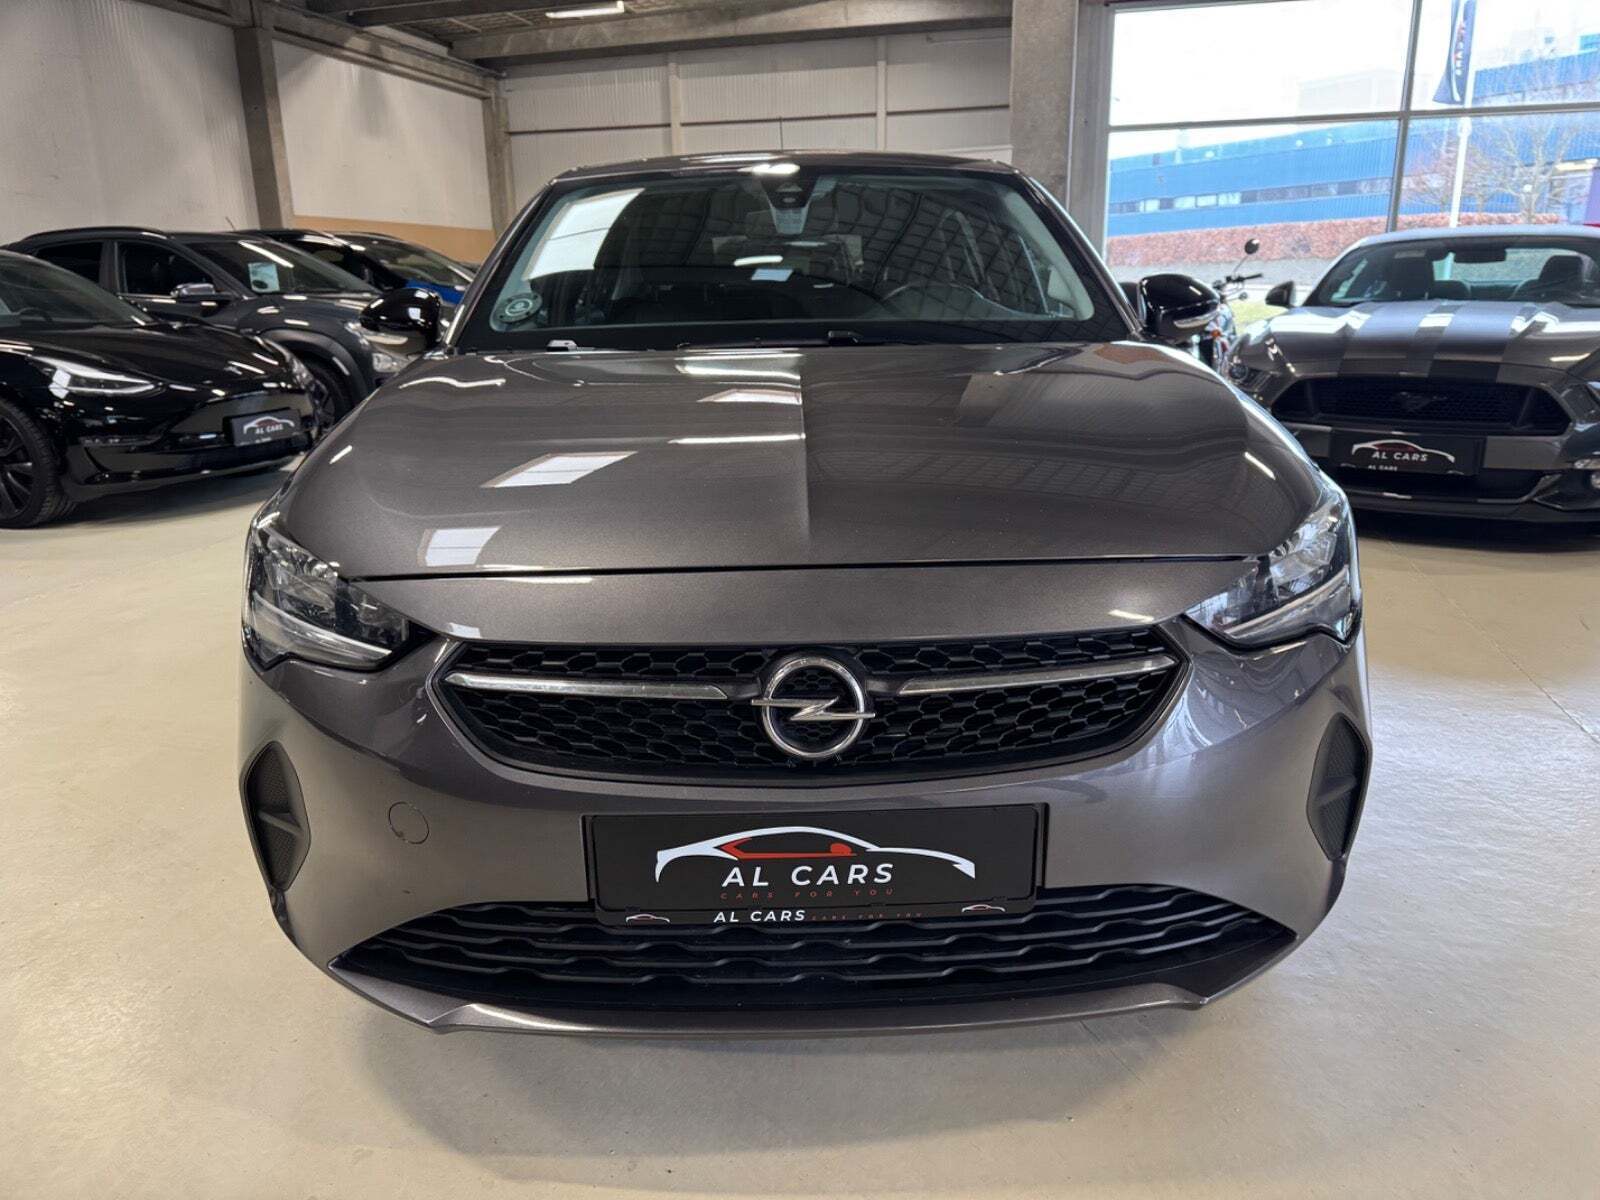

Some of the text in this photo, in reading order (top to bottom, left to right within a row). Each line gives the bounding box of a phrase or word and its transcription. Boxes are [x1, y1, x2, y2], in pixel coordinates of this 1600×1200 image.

[1372, 451, 1428, 461] AL CARS
[721, 863, 894, 887] AL CARS
[720, 888, 894, 900] CARS FOR YOU
[713, 911, 739, 923] AL
[750, 910, 806, 922] CARS
